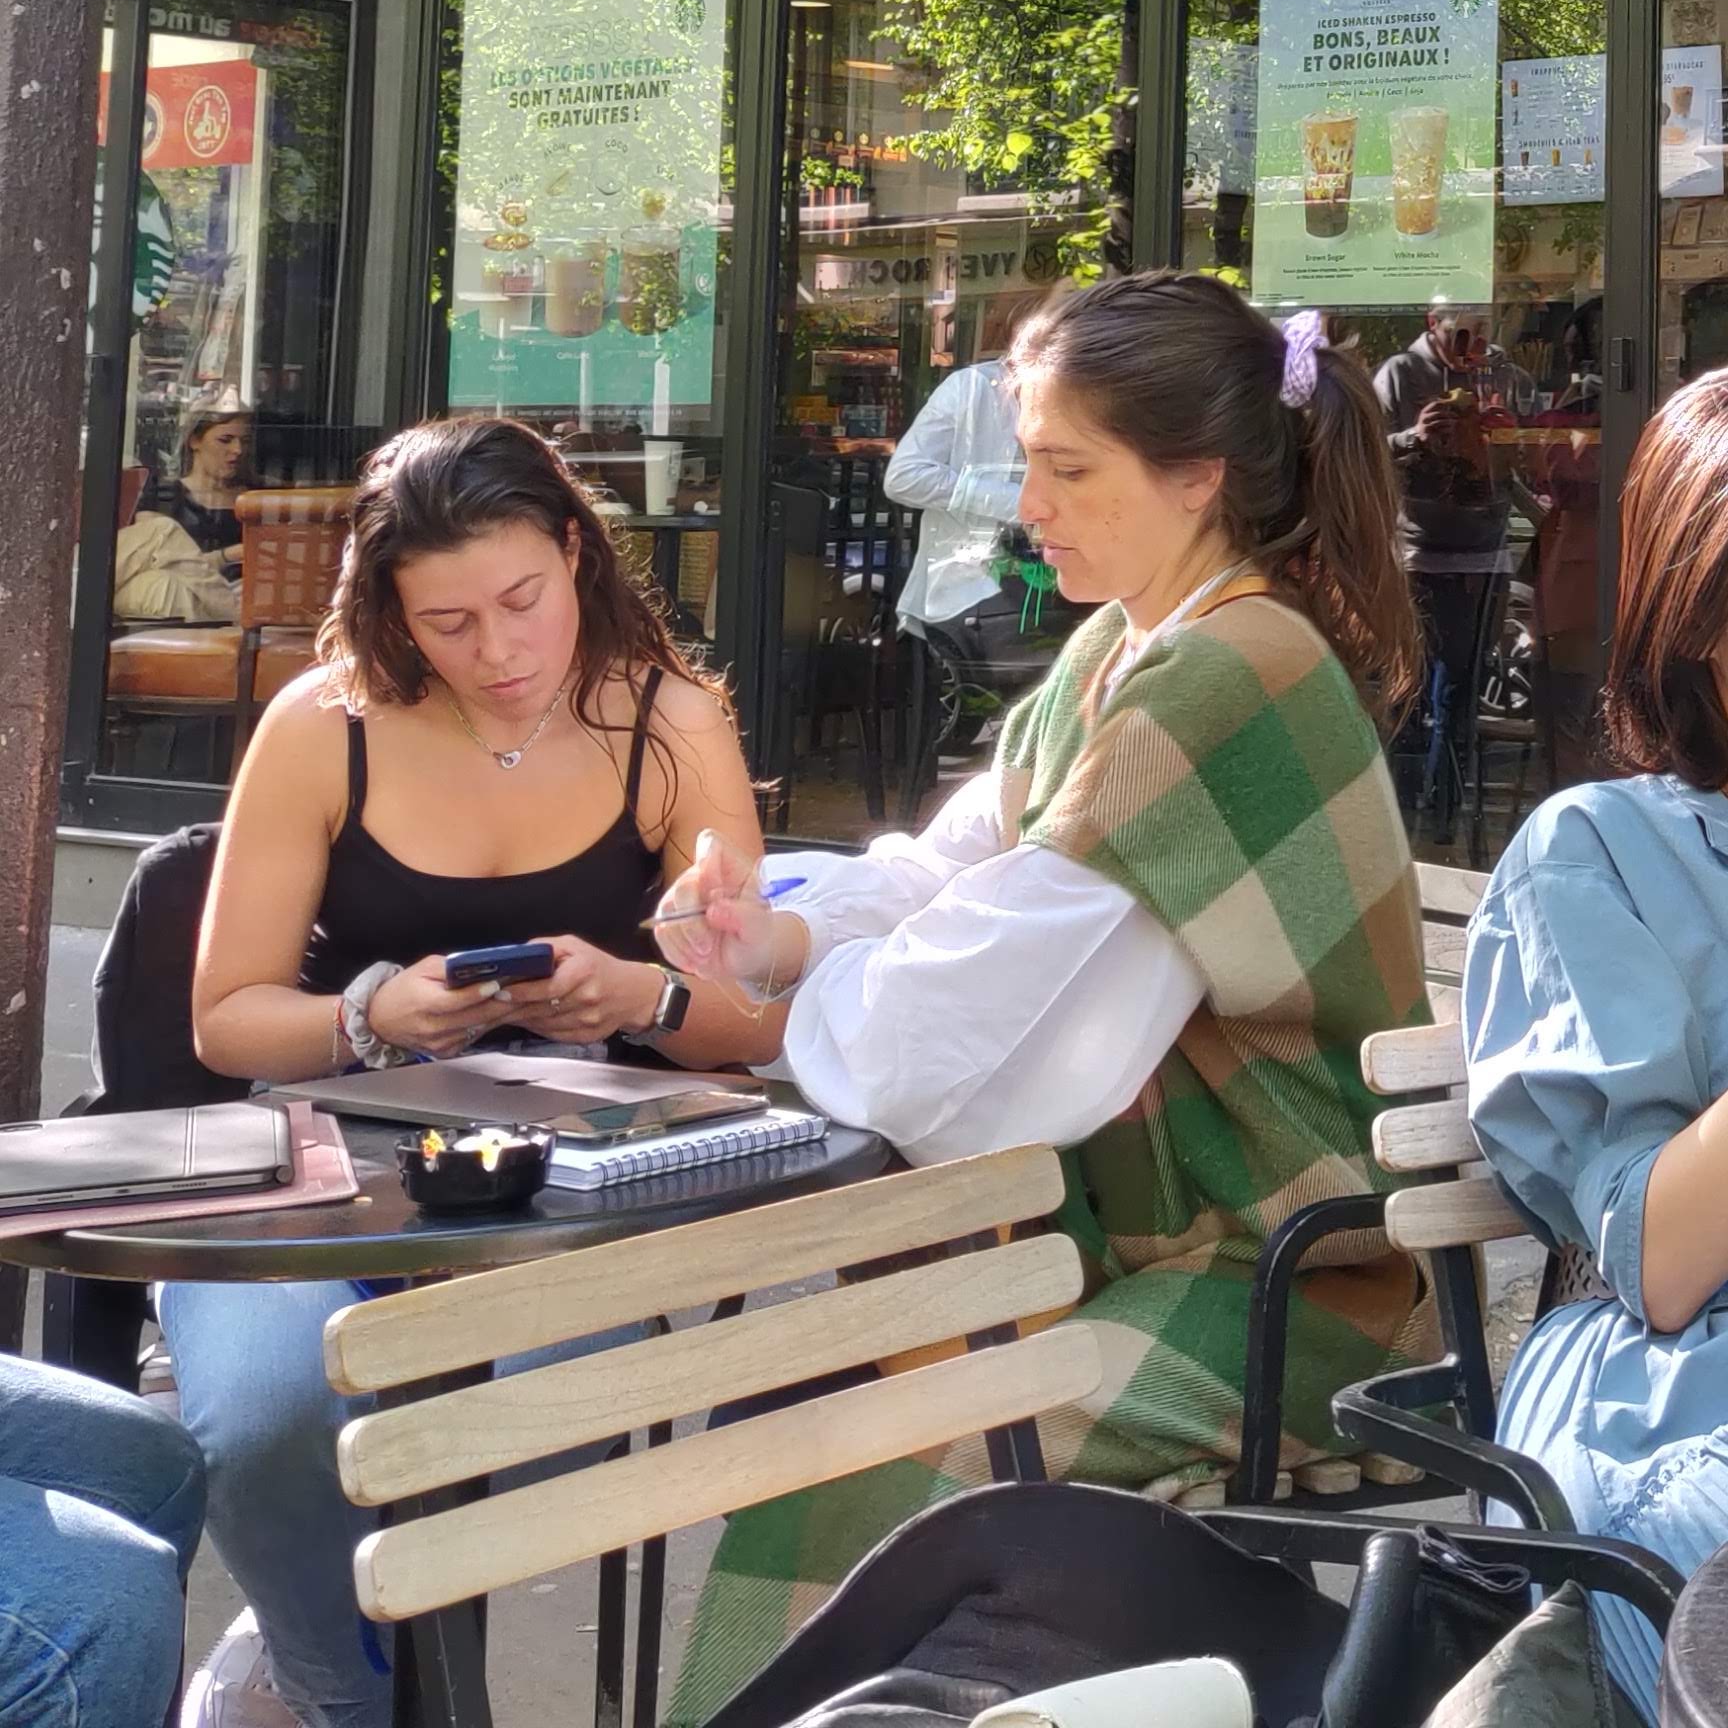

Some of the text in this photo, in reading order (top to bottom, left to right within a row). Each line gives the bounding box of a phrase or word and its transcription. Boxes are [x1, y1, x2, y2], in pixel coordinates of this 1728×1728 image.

[1317, 12, 1436, 29] ICED SHAKEN ESPRESSO
[1313, 26, 1441, 51] BONS, BEAUX
[1303, 47, 1450, 73] ET ORIGINAUX !
[508, 80, 671, 109] SONT MAINTENANT
[537, 107, 629, 129] GRATUITES
